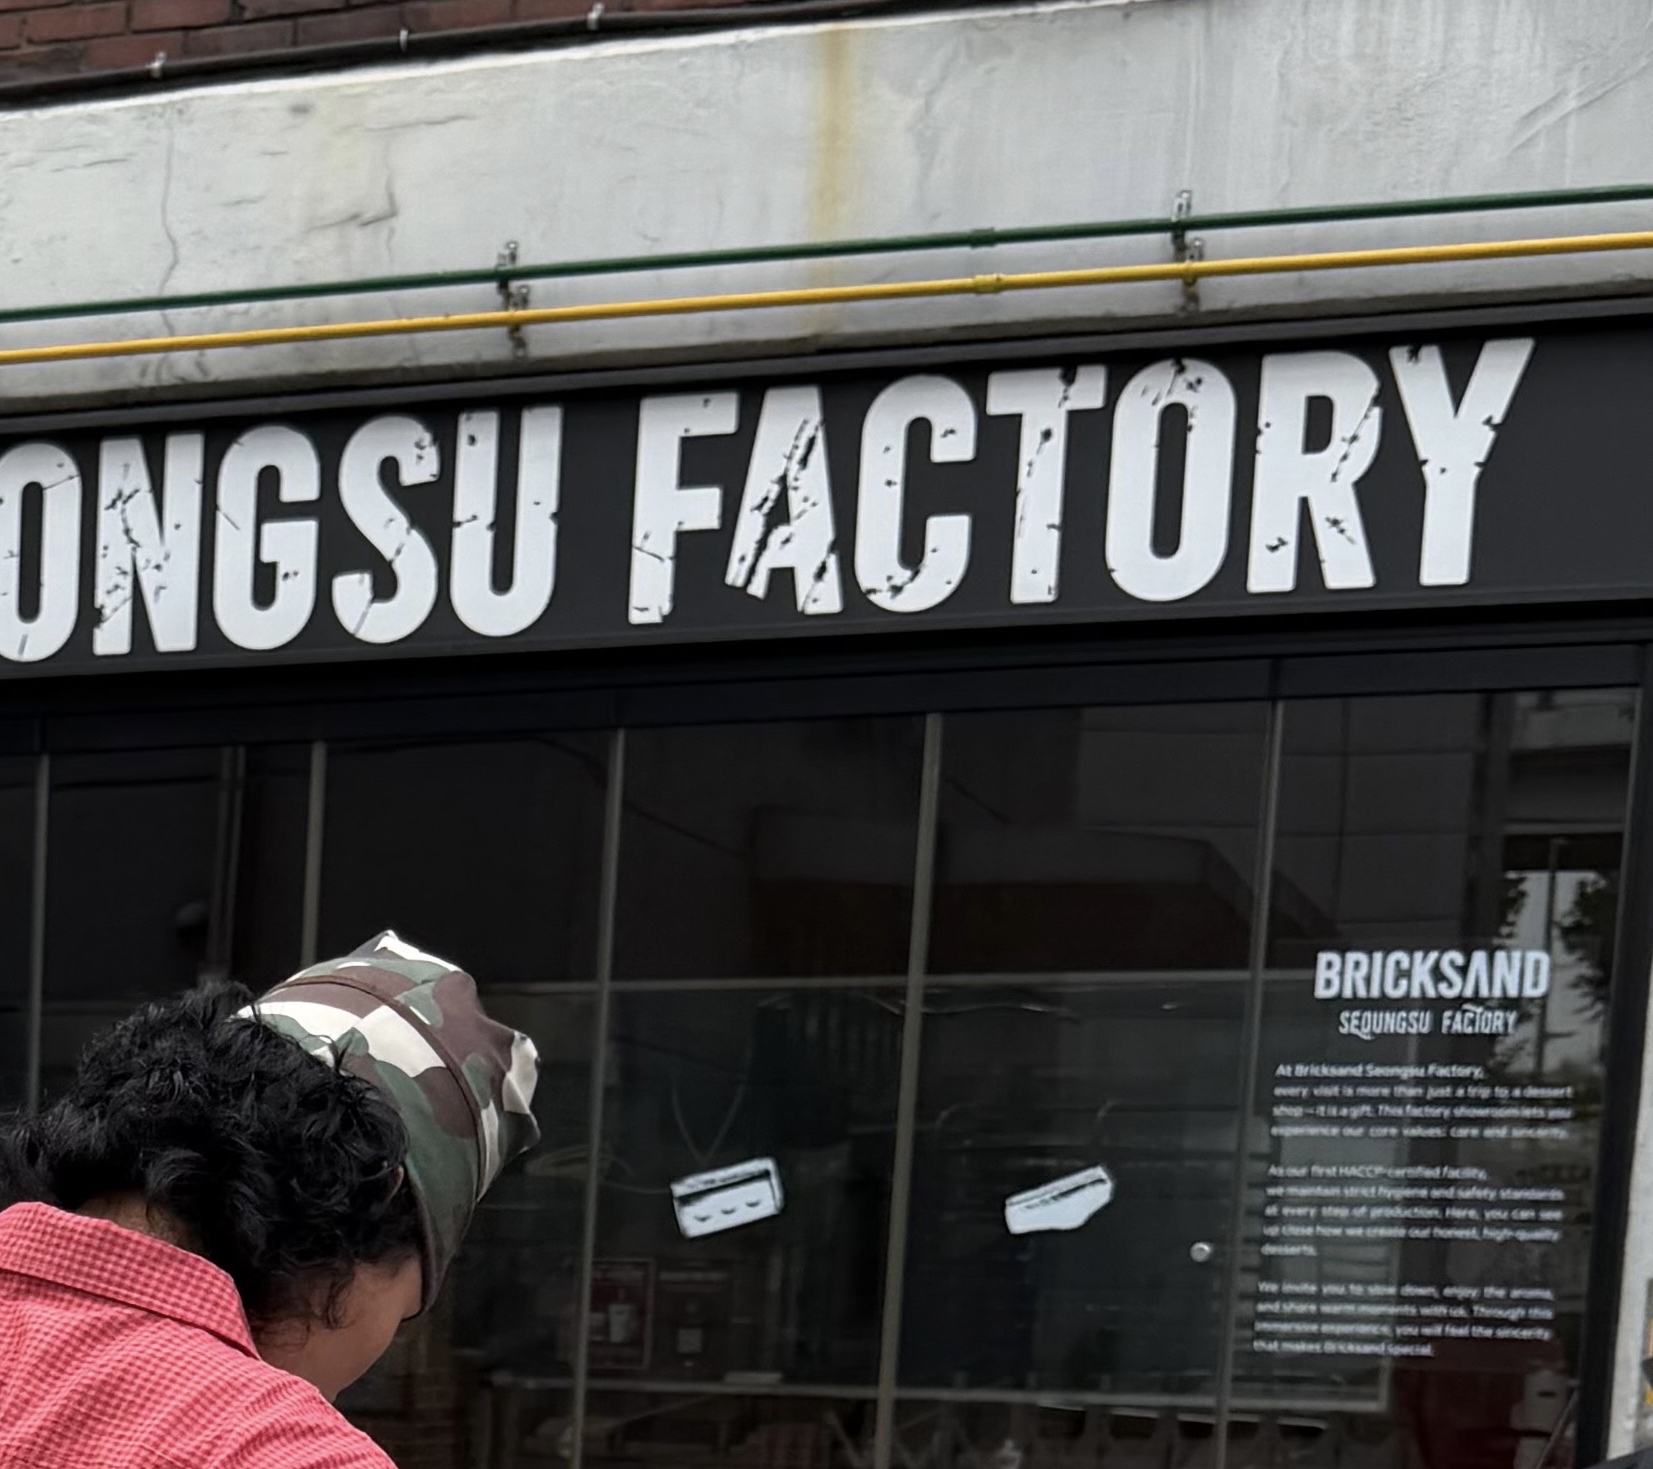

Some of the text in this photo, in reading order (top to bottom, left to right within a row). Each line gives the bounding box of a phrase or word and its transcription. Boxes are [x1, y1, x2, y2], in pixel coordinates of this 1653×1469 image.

[626, 337, 1535, 626] FACTORY
[1313, 949, 1551, 999] BRICKSAND
[1441, 1002, 1518, 1034] FACTORY
